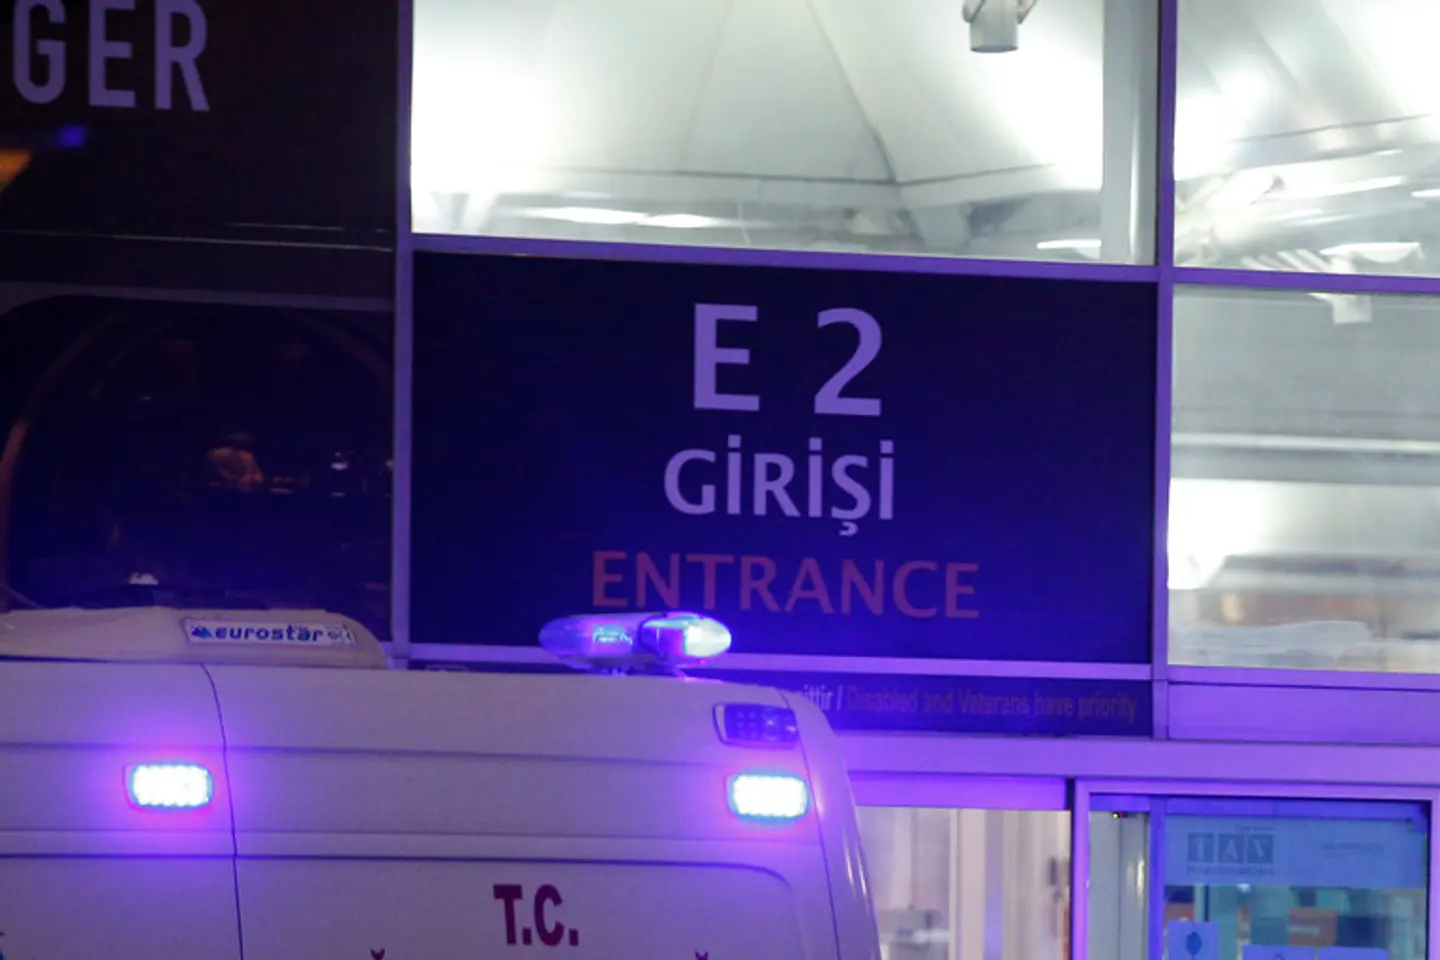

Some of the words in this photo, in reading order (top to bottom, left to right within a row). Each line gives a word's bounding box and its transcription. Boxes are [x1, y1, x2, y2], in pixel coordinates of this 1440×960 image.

[694, 303, 760, 411] E
[813, 307, 883, 416] 2
[663, 434, 894, 537] GİRİŞİ
[591, 550, 980, 620] ENTRANCE
[923, 688, 953, 713] and
[958, 687, 1030, 715] Veterans
[1034, 691, 1073, 716] have
[1079, 693, 1139, 725] priority
[493, 884, 579, 946] T.C.
